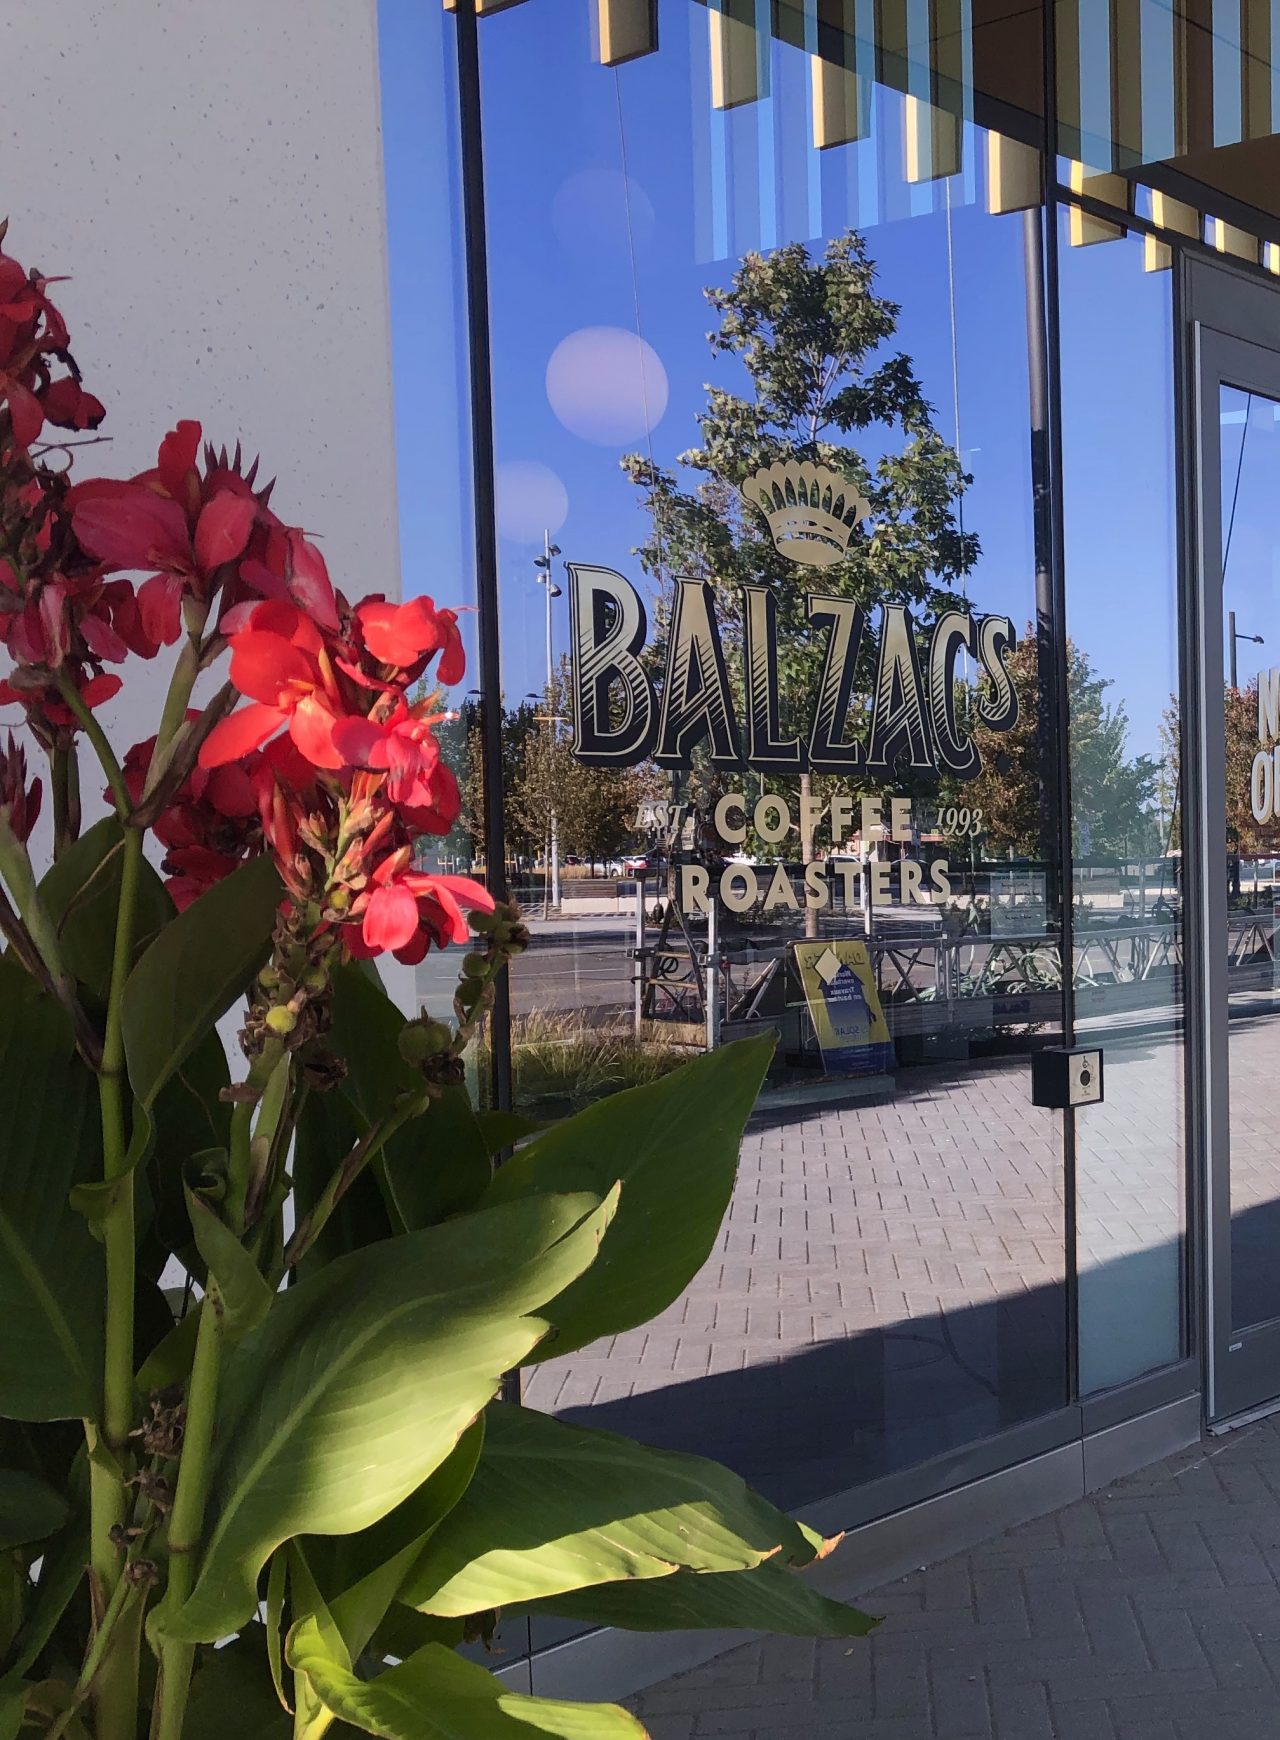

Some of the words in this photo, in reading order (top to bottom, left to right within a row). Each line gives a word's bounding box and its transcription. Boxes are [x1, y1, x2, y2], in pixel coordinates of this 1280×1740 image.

[714, 793, 913, 844] COFFEE
[935, 806, 985, 838] 1993
[681, 858, 951, 914] ROASTERS
